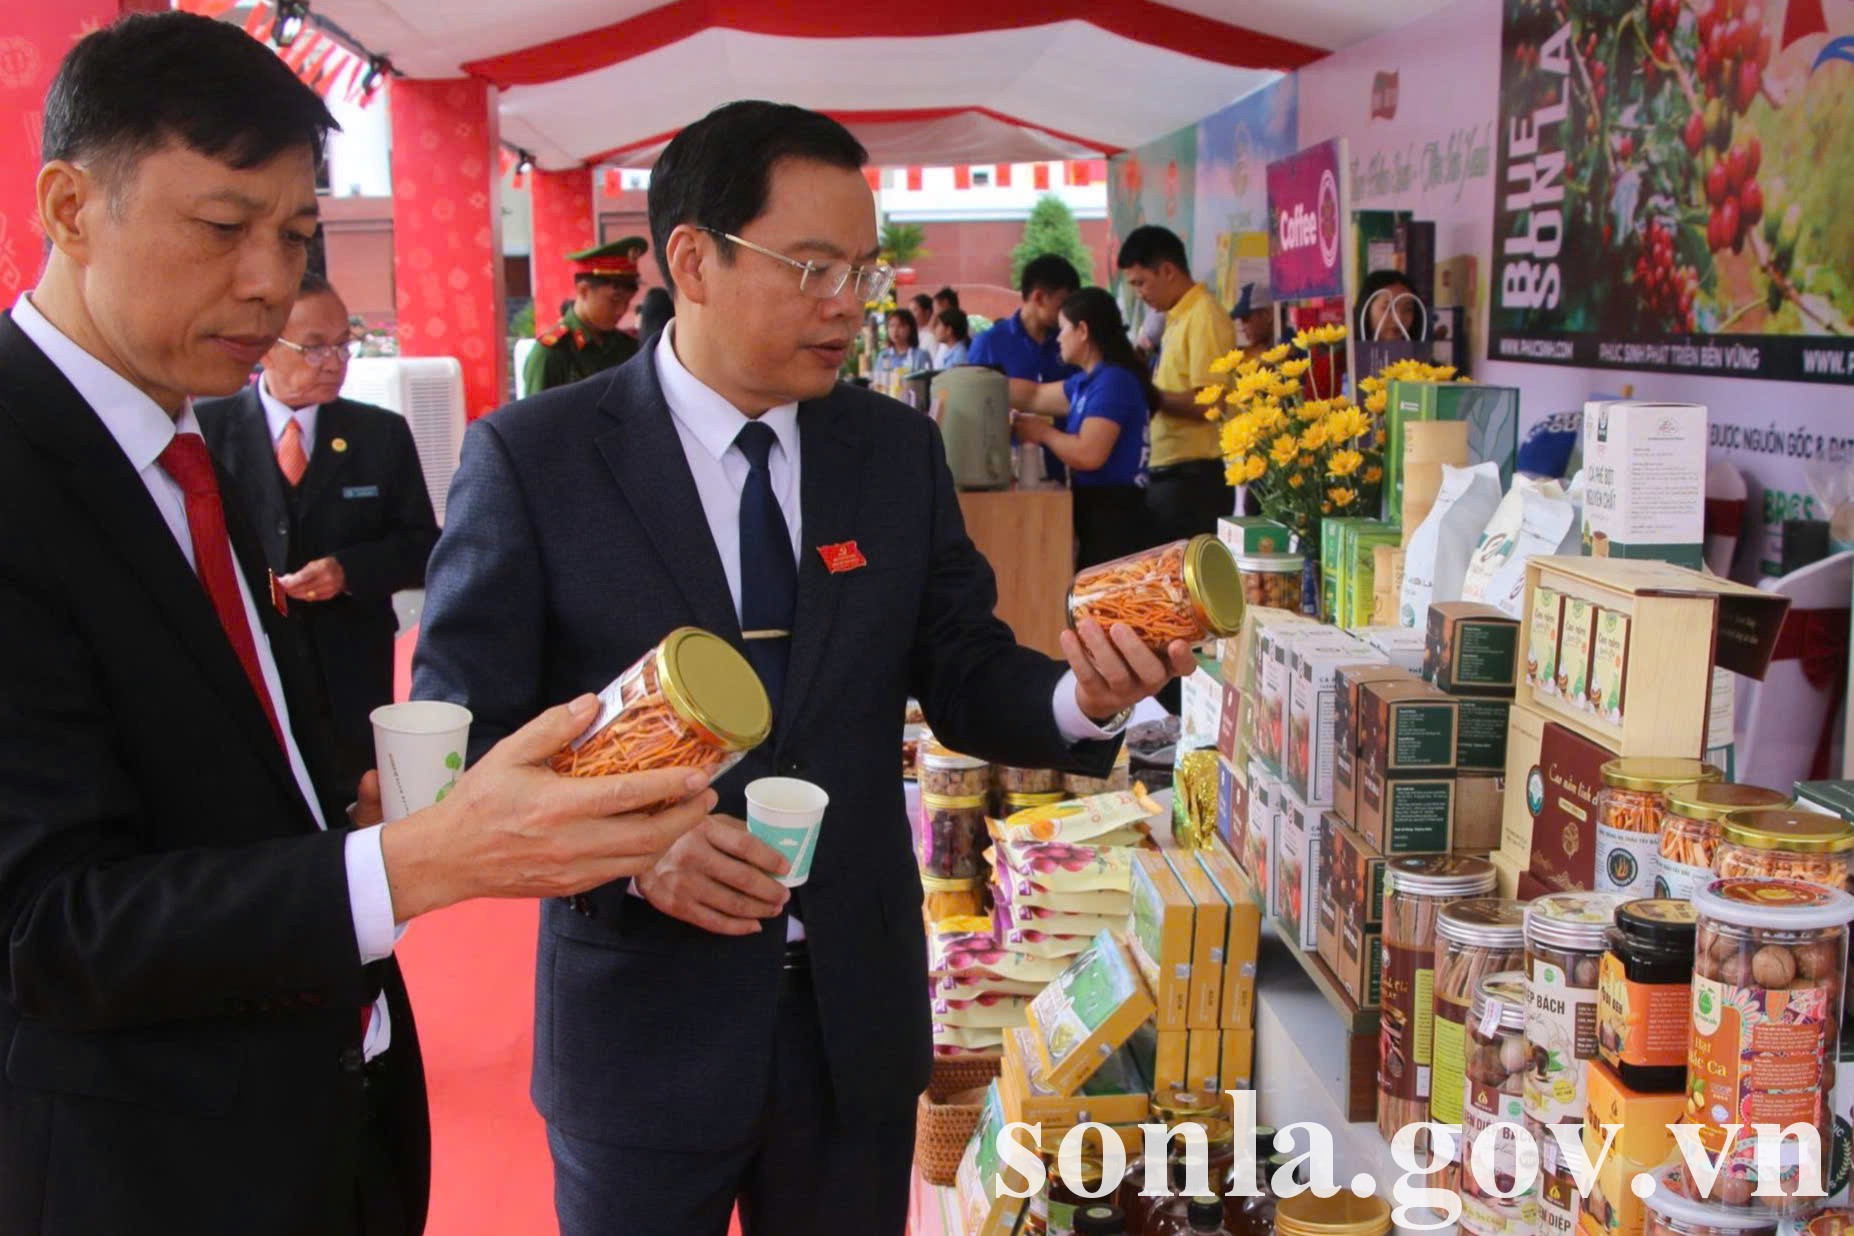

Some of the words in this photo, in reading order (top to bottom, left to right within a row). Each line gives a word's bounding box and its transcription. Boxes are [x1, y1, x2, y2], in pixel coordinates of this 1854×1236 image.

[1535, 20, 1573, 125] LA
[1502, 113, 1539, 308] BLUE
[1280, 203, 1317, 251] Coffee
[1725, 342, 1760, 371] VỮNG
[1549, 763, 1563, 785] Cao
[1537, 994, 1565, 1015] BÁCH
[1707, 1060, 1727, 1077] Ca
